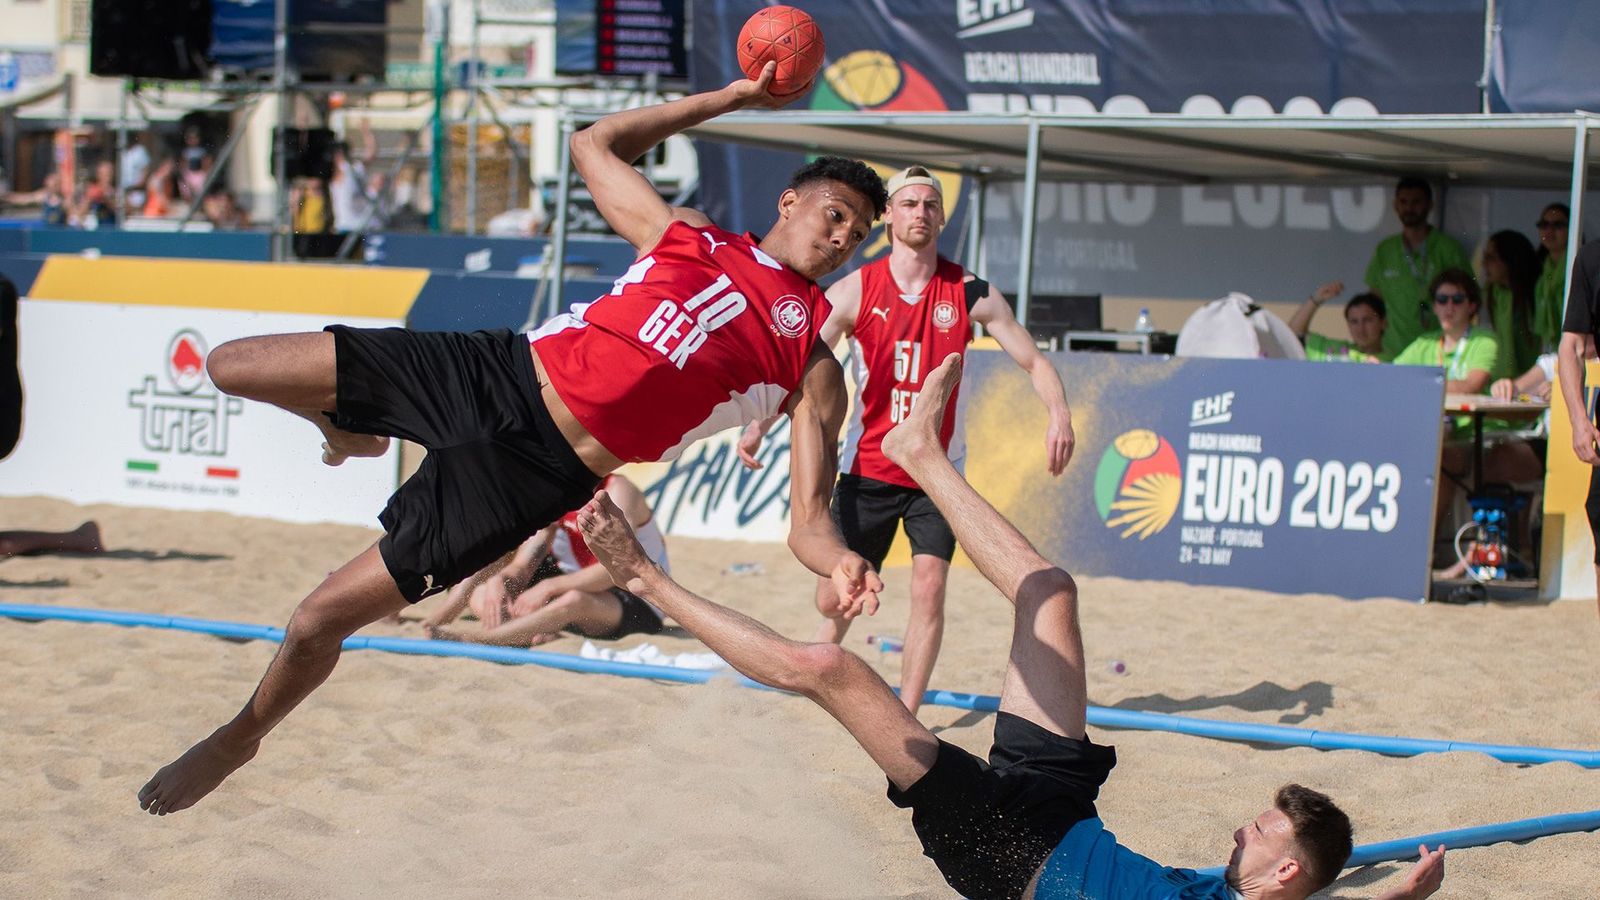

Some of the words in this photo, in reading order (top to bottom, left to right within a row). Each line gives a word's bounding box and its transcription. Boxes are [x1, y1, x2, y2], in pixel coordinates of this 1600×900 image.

[964, 52, 1018, 82] BEACH
[1020, 53, 1100, 85] HANDBALL
[683, 273, 747, 333] 10
[638, 299, 708, 370] GER
[894, 340, 921, 384] 51
[1191, 391, 1235, 421] EHF
[1189, 432, 1218, 450] BEACH
[1218, 433, 1262, 453] HANDBALL
[1182, 453, 1284, 526] EURO
[1289, 458, 1401, 533] 2023
[1220, 528, 1264, 548] PORTUGAL
